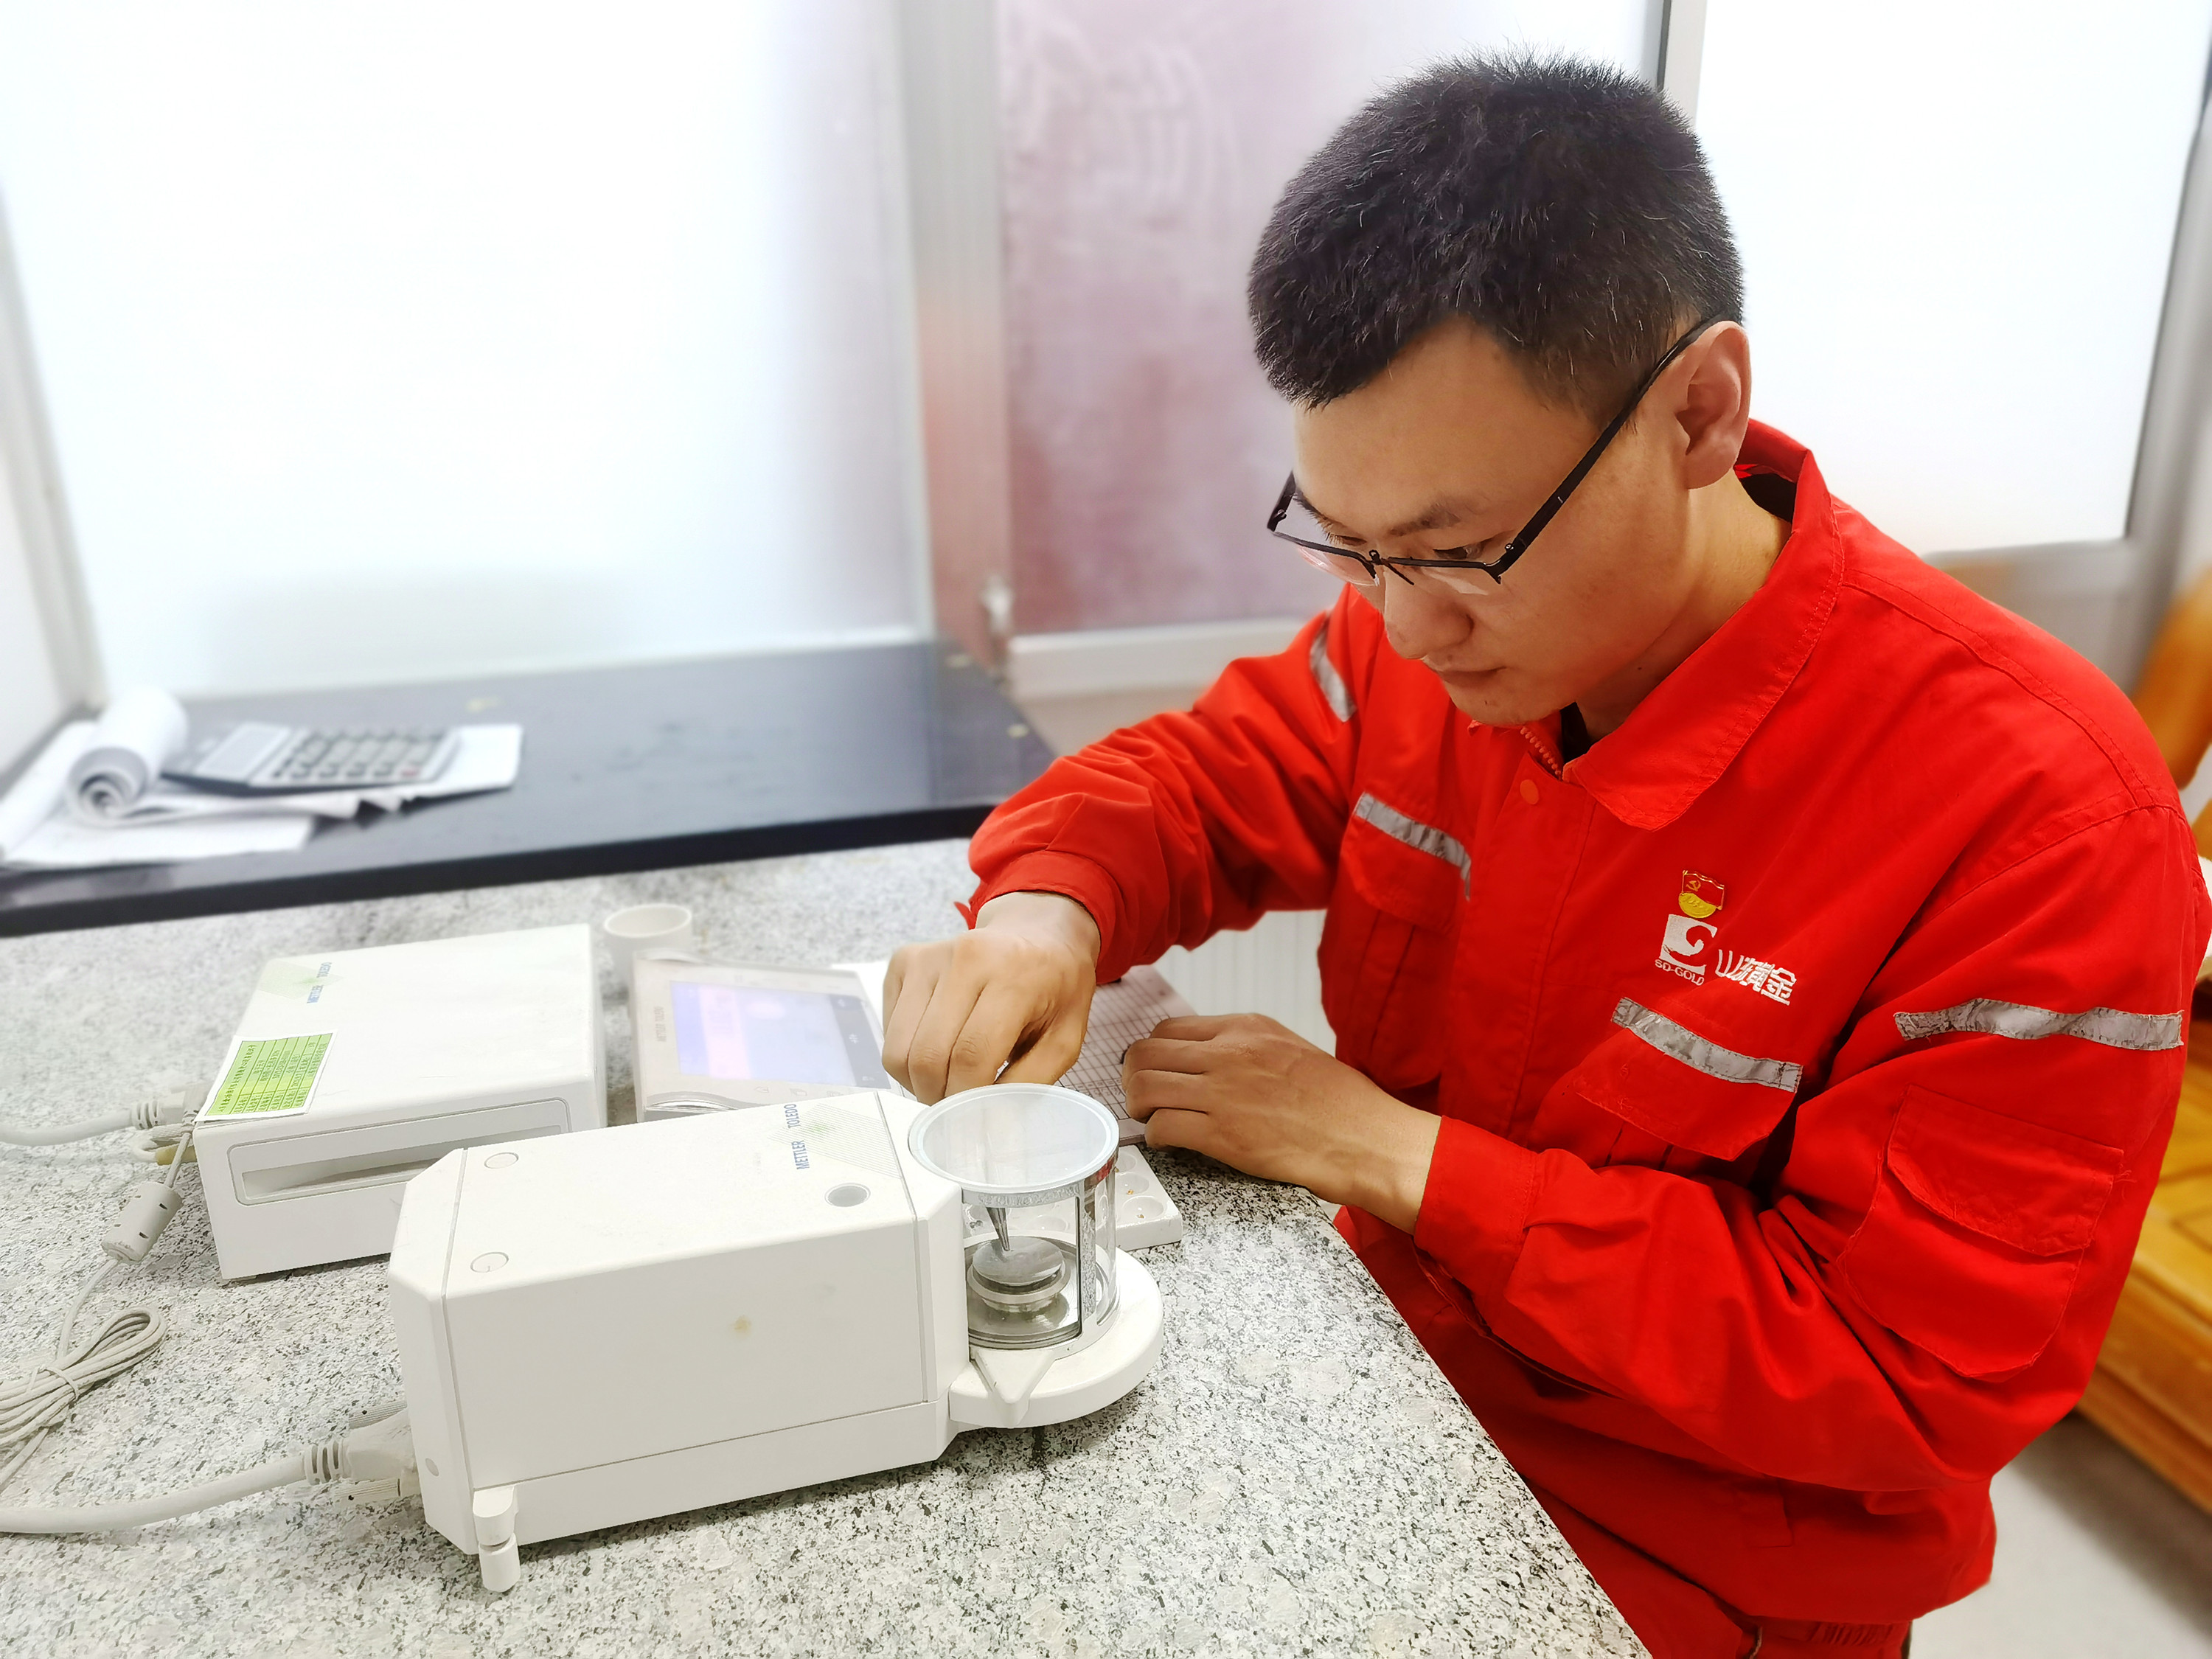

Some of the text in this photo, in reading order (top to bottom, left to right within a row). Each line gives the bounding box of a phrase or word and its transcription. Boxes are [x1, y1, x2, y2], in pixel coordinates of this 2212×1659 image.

[1655, 959, 1705, 986] SD-GOLD
[783, 1103, 810, 1170] METTLER TOLEDO
